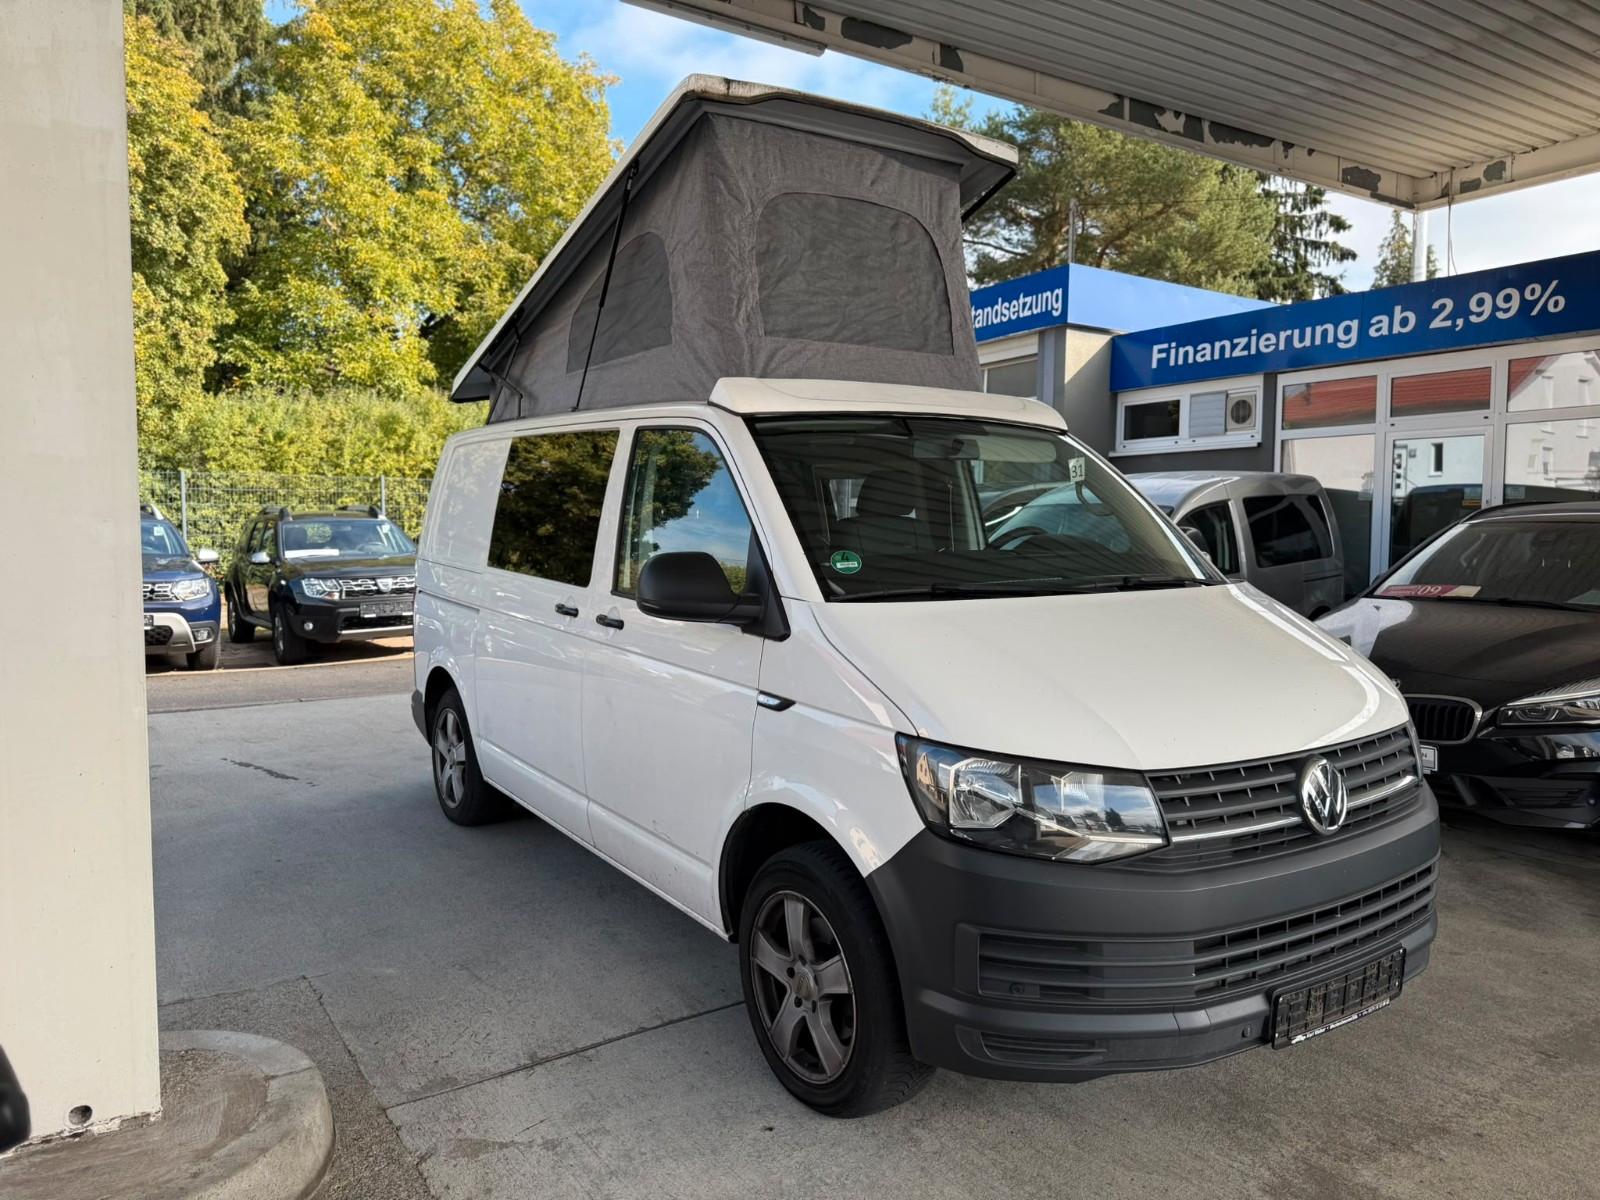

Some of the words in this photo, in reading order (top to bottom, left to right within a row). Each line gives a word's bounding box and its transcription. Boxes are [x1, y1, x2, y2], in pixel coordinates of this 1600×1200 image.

[1150, 319, 1360, 370] Finanzierung
[1368, 306, 1416, 339] ab
[1429, 280, 1566, 331] 2,99%
[1071, 464, 1084, 479] 31
[840, 551, 850, 562] 4
